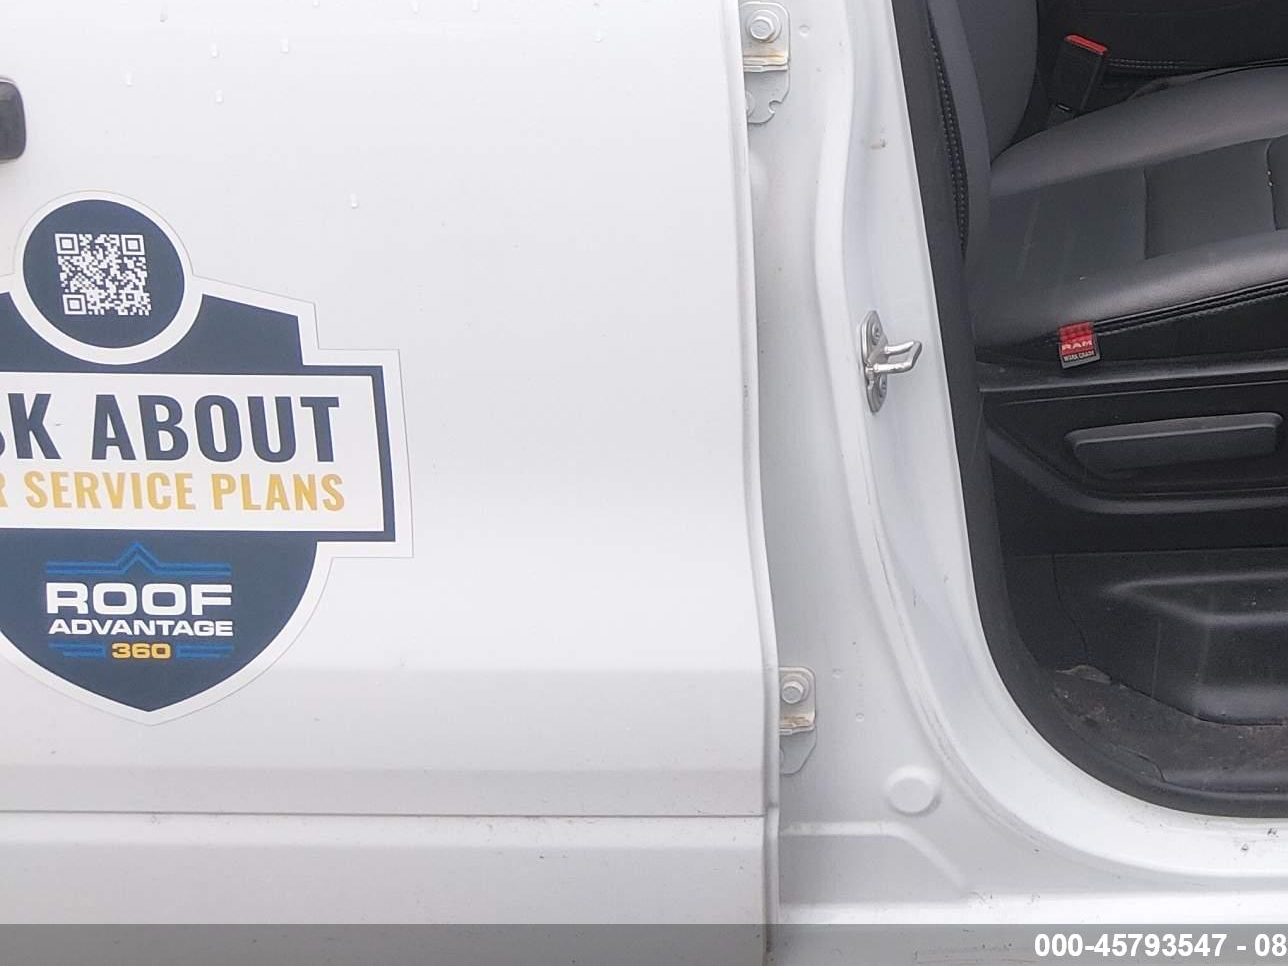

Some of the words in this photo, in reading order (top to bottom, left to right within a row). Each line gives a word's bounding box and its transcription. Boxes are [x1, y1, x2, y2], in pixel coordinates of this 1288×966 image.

[1061, 340, 1092, 350] RAM
[0, 393, 61, 460] K
[92, 395, 339, 463] ABOUT
[24, 471, 196, 510] SERVICE
[211, 473, 345, 511] PLANS
[46, 583, 232, 616] ROOF
[49, 619, 233, 636] ADVANTAGE
[112, 643, 171, 659] 360
